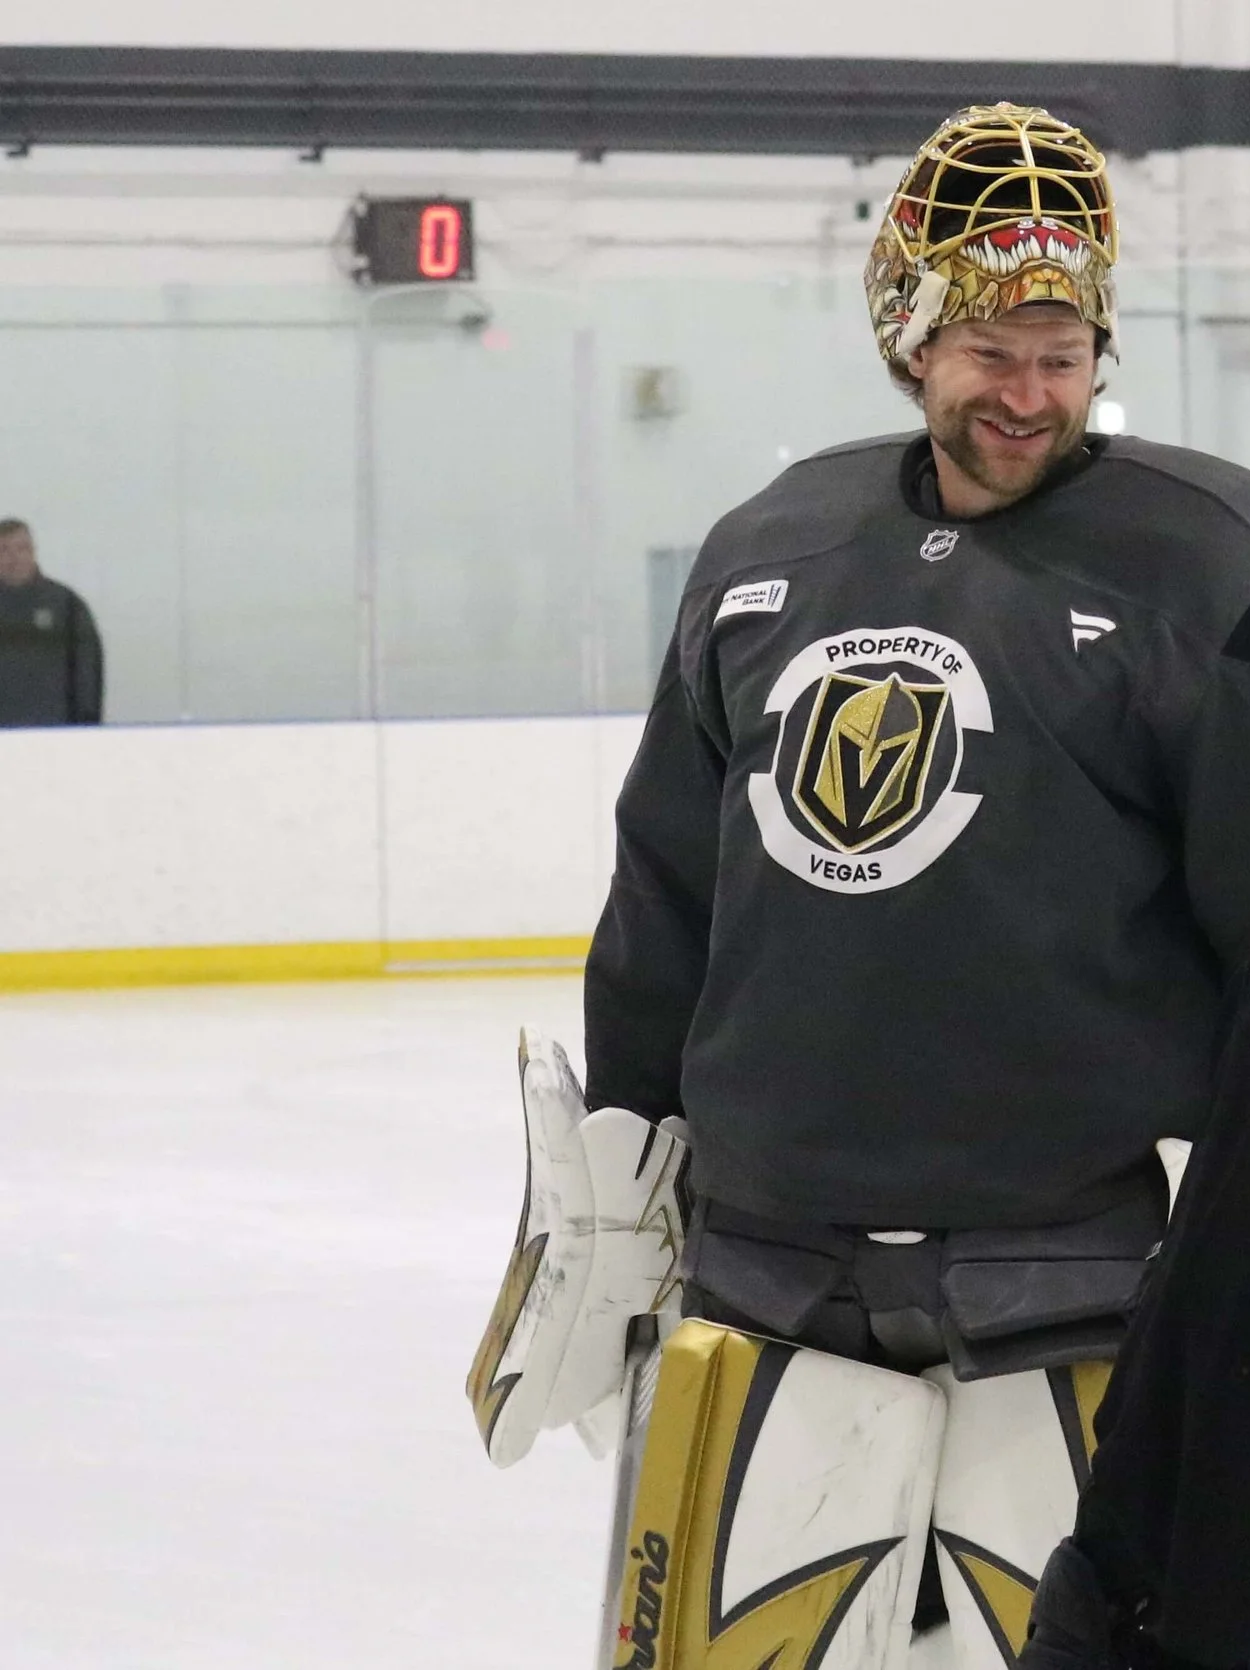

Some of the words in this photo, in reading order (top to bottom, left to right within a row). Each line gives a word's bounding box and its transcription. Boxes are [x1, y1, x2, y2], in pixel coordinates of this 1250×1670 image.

[418, 205, 461, 277] 0
[927, 539, 951, 555] NHL
[732, 590, 766, 600] NATIONAL
[826, 637, 944, 662] PROPERTY
[942, 653, 963, 675] OF
[810, 854, 882, 882] VEGAS
